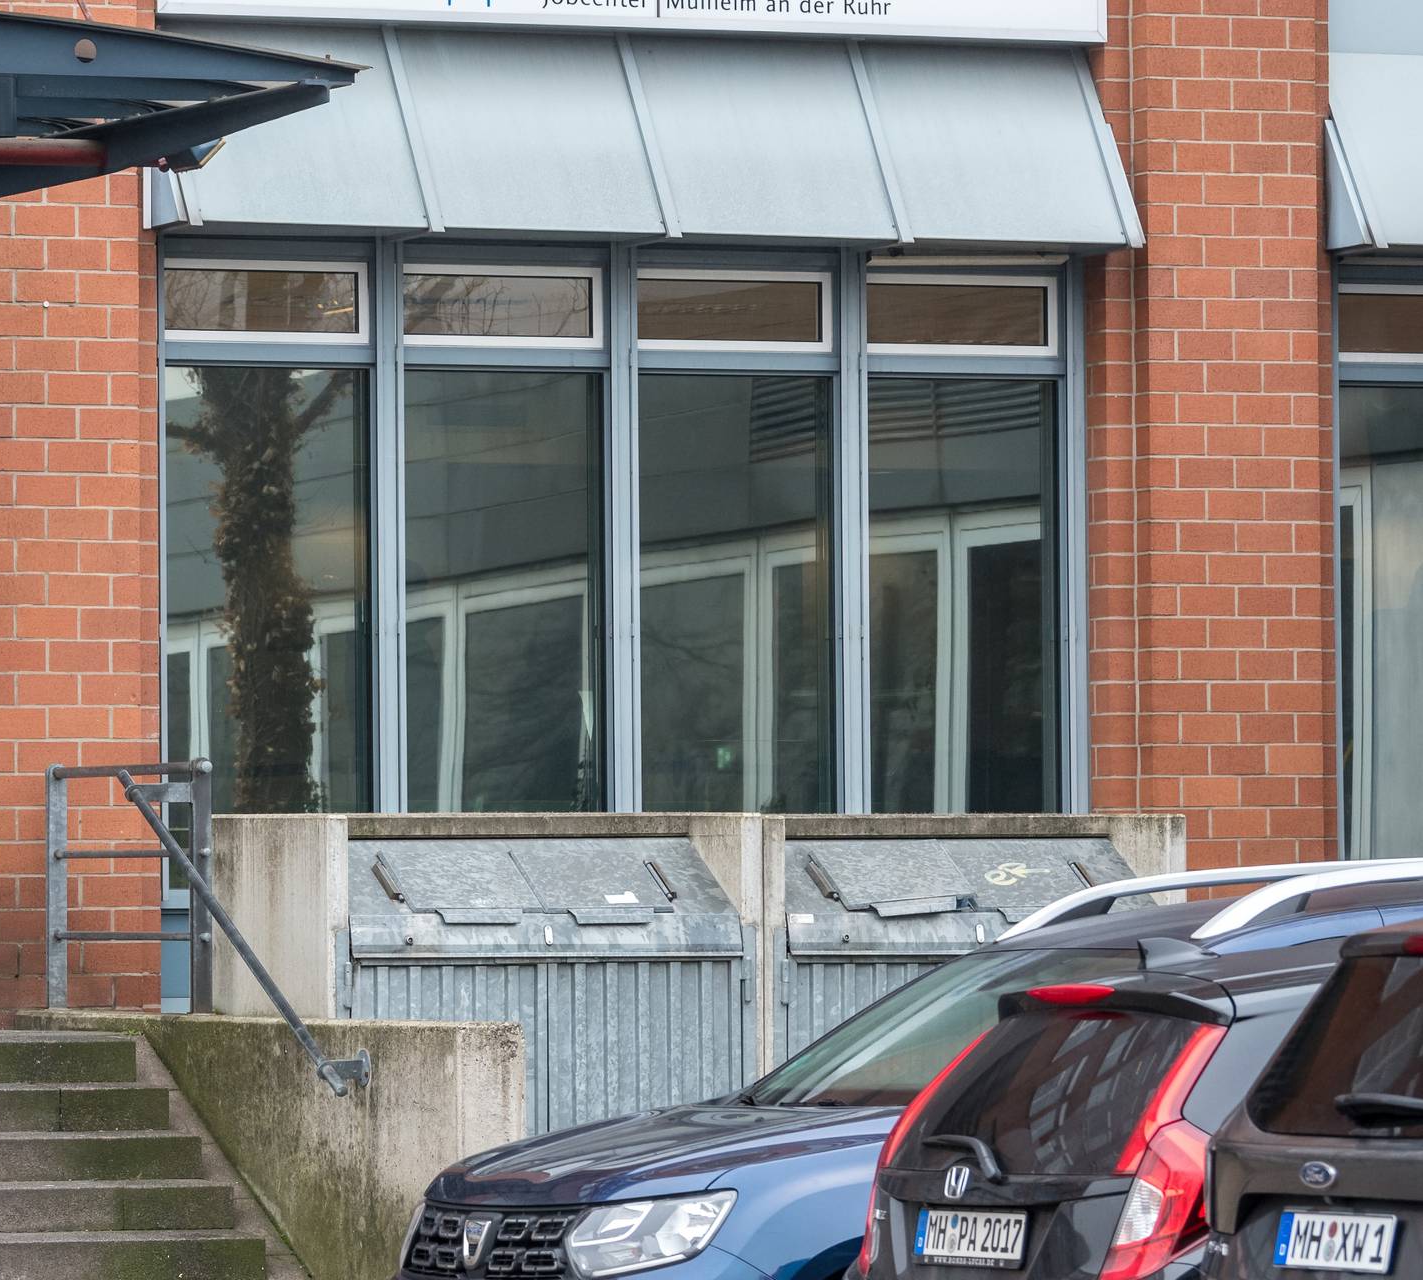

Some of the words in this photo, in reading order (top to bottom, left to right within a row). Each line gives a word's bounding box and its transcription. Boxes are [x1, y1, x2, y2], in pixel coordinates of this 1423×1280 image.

[766, 0, 790, 12] an
[800, 0, 835, 14] der
[844, 0, 892, 15] Ruhr
[926, 1215, 948, 1250] MH
[957, 1216, 978, 1251] PA
[980, 1217, 1023, 1253] 2017
[1291, 1220, 1324, 1260] MH
[1335, 1222, 1369, 1262] XW
[1369, 1224, 1385, 1263] 1
